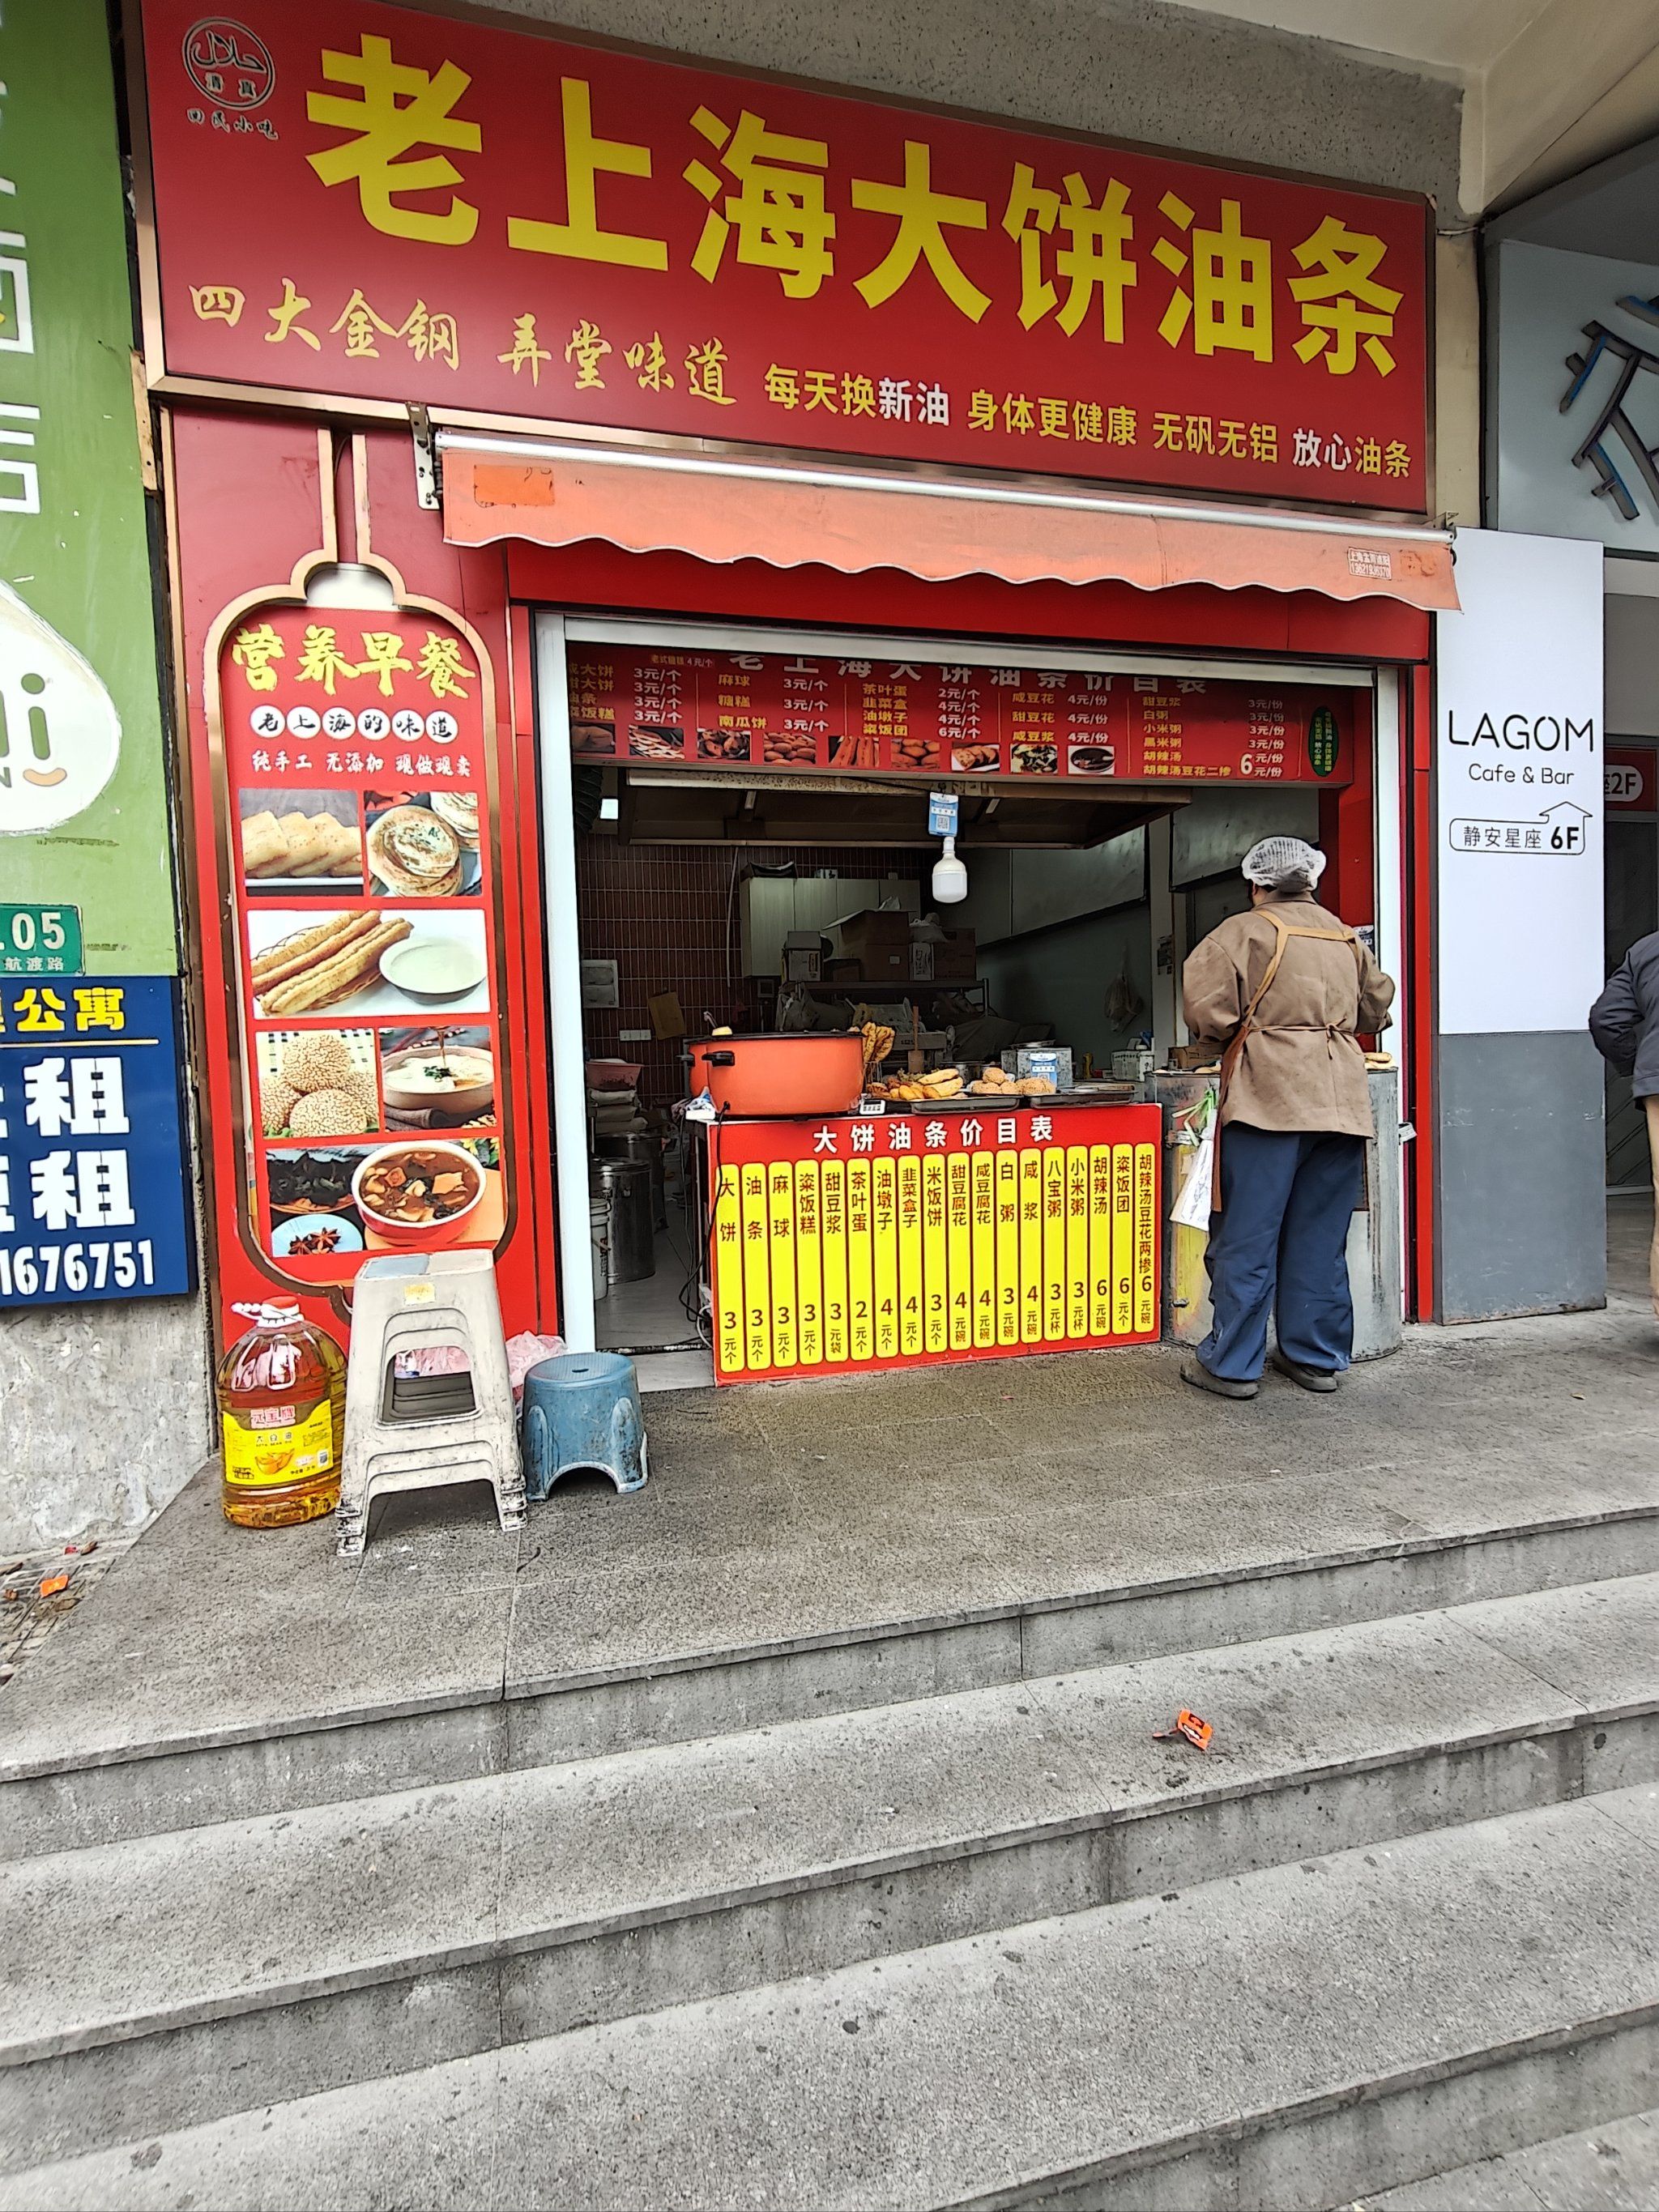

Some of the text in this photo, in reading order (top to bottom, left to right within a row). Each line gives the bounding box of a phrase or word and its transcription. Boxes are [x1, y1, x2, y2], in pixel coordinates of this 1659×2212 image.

[305, 33, 1404, 377] 老上海大饼油条
[189, 277, 1412, 479] 四大金钢 弄堂味道 每天换新油 身体更健康 无矾无铝 放心油条
[232, 623, 477, 699] 营养早餐
[633, 668, 682, 682] 3元/个
[633, 682, 682, 696] 3元/个
[719, 674, 829, 692] 麻球 3元/个
[863, 683, 980, 701] 茶叶蛋 2元/个
[1068, 694, 1108, 706] 4元/份
[634, 696, 682, 710] 3元/个
[634, 710, 683, 724] 3元/个
[783, 698, 829, 713] 3元/个
[938, 701, 980, 714] 4元/个
[938, 714, 981, 727] 4元/个
[1068, 713, 1108, 725] 4元/份
[1143, 710, 1168, 721] 白粥
[255, 710, 455, 740] 老上海的味道
[719, 715, 830, 732] 南瓜饼 3元/个
[938, 727, 982, 739] 6元/个
[1068, 731, 1109, 744] 4元/份
[1143, 723, 1286, 736] 小米粥 3元/份
[1448, 710, 1594, 752] LAGOM
[252, 749, 313, 773] 纯手工
[395, 754, 471, 778] 现做现卖
[1143, 750, 1182, 762] 胡辣汤
[1240, 752, 1253, 776] 6
[1248, 739, 1285, 750] 3元/份
[1469, 763, 1575, 785] Cafe & Bar
[1463, 825, 1580, 850] 静安星座 6F
[0, 912, 66, 951] 05
[5, 957, 64, 972] 航渡路
[0, 987, 125, 1032] 公寓
[0, 1056, 130, 1136] 租
[812, 1115, 1055, 1154] 大饼油条价目表
[825, 1172, 842, 1234] 甜豆浆
[902, 1168, 919, 1348] 韭菜盒子 4 元个
[927, 1166, 942, 1345] 米饭饼 3 元个
[951, 1165, 967, 1343] 甜豆腐花 4 元碗
[975, 1163, 992, 1340] 咸豆腐花 4 元碗
[1000, 1161, 1015, 1338] 白粥 3 元碗
[1023, 1160, 1038, 1336] 咸浆 4 元碗
[1047, 1160, 1061, 1334] 八宝粥 3 元杯
[1070, 1157, 1085, 1332] 小米粥 3 元杯
[1093, 1156, 1107, 1329] 胡辣汤 6 元碗
[1116, 1155, 1130, 1327] 粢饭团 6 元个
[1139, 1154, 1152, 1324] 胡辣汤豆花两掺 6 元碗
[0, 1238, 155, 1296] 1676751
[719, 1178, 737, 1365] 大饼 3 元个
[747, 1175, 763, 1362] 油条 3 元个
[772, 1174, 790, 1359] 麻球 3 元个
[800, 1172, 816, 1357] 粢饭糕 3 元个
[851, 1170, 868, 1353] 茶叶蛋 2 元个
[876, 1169, 893, 1350] 油墩子 4 元个
[830, 1302, 842, 1320] 3
